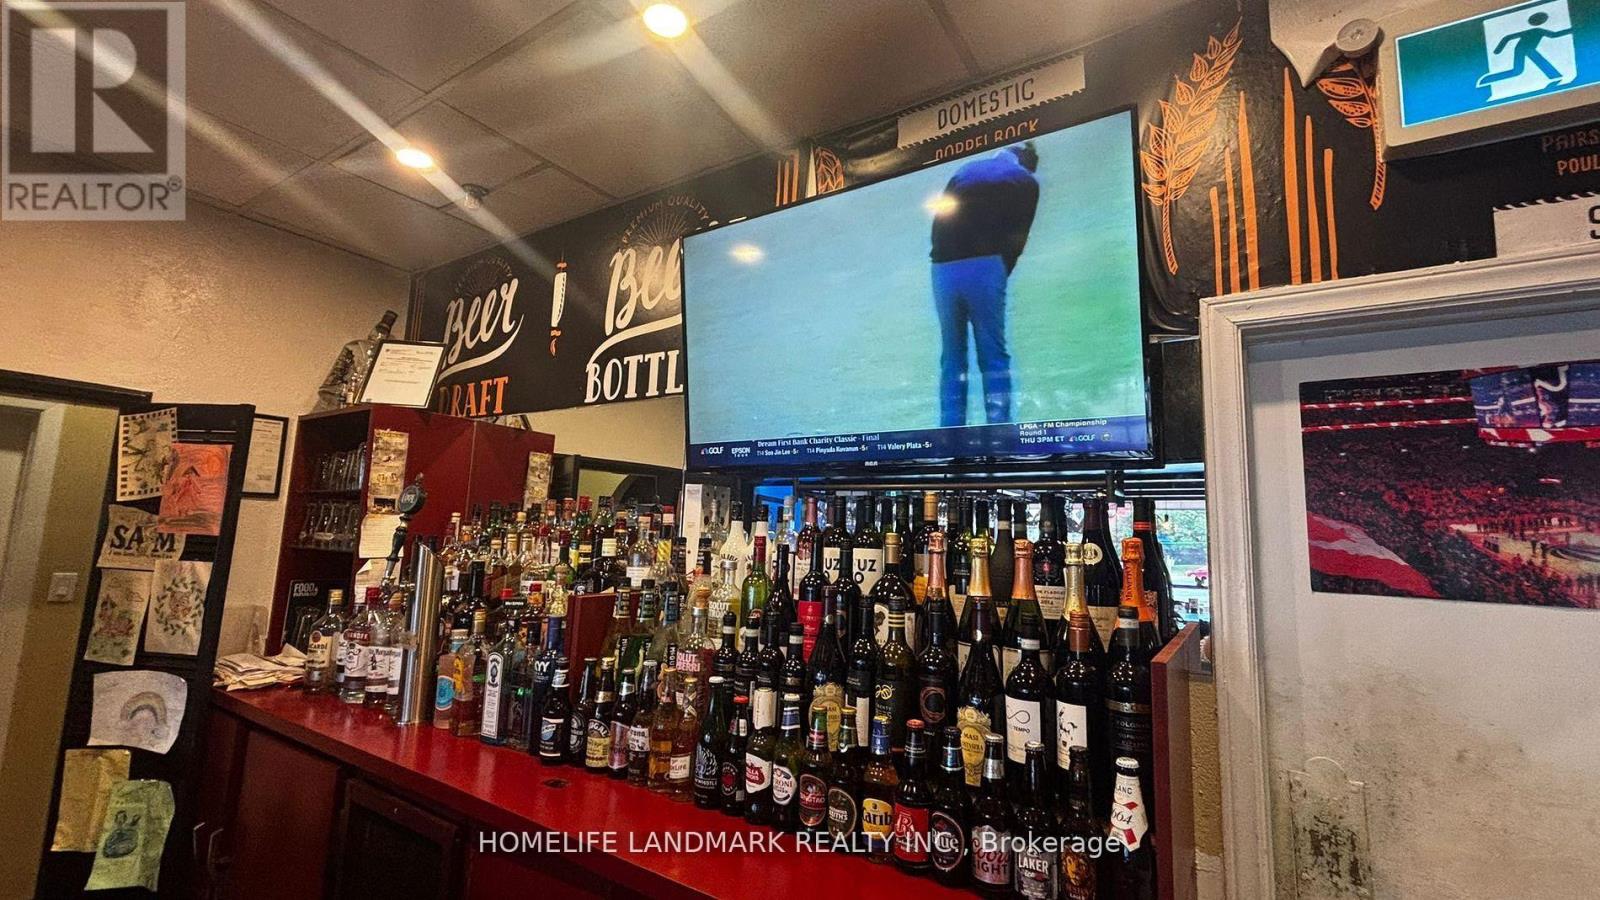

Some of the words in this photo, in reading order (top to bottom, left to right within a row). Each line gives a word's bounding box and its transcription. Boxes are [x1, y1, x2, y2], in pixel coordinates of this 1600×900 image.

[937, 78, 1036, 130] DOMESTIC
[1556, 154, 1600, 176] POUL
[604, 237, 682, 336] Bee
[442, 278, 518, 369] Beer
[584, 350, 684, 403] BOTTL
[438, 376, 509, 417] DRAFT
[1055, 418, 1107, 428] Championship
[778, 439, 791, 447] First
[792, 438, 808, 446] Bank
[809, 437, 833, 445] Charity
[862, 433, 880, 441] Final
[887, 442, 906, 451] Valery
[708, 446, 724, 456] GOLF
[731, 447, 751, 455] EPSON
[1013, 726, 1031, 734] TEMPO
[977, 860, 1008, 875] IGHT
[1018, 854, 1049, 874] LAKER
